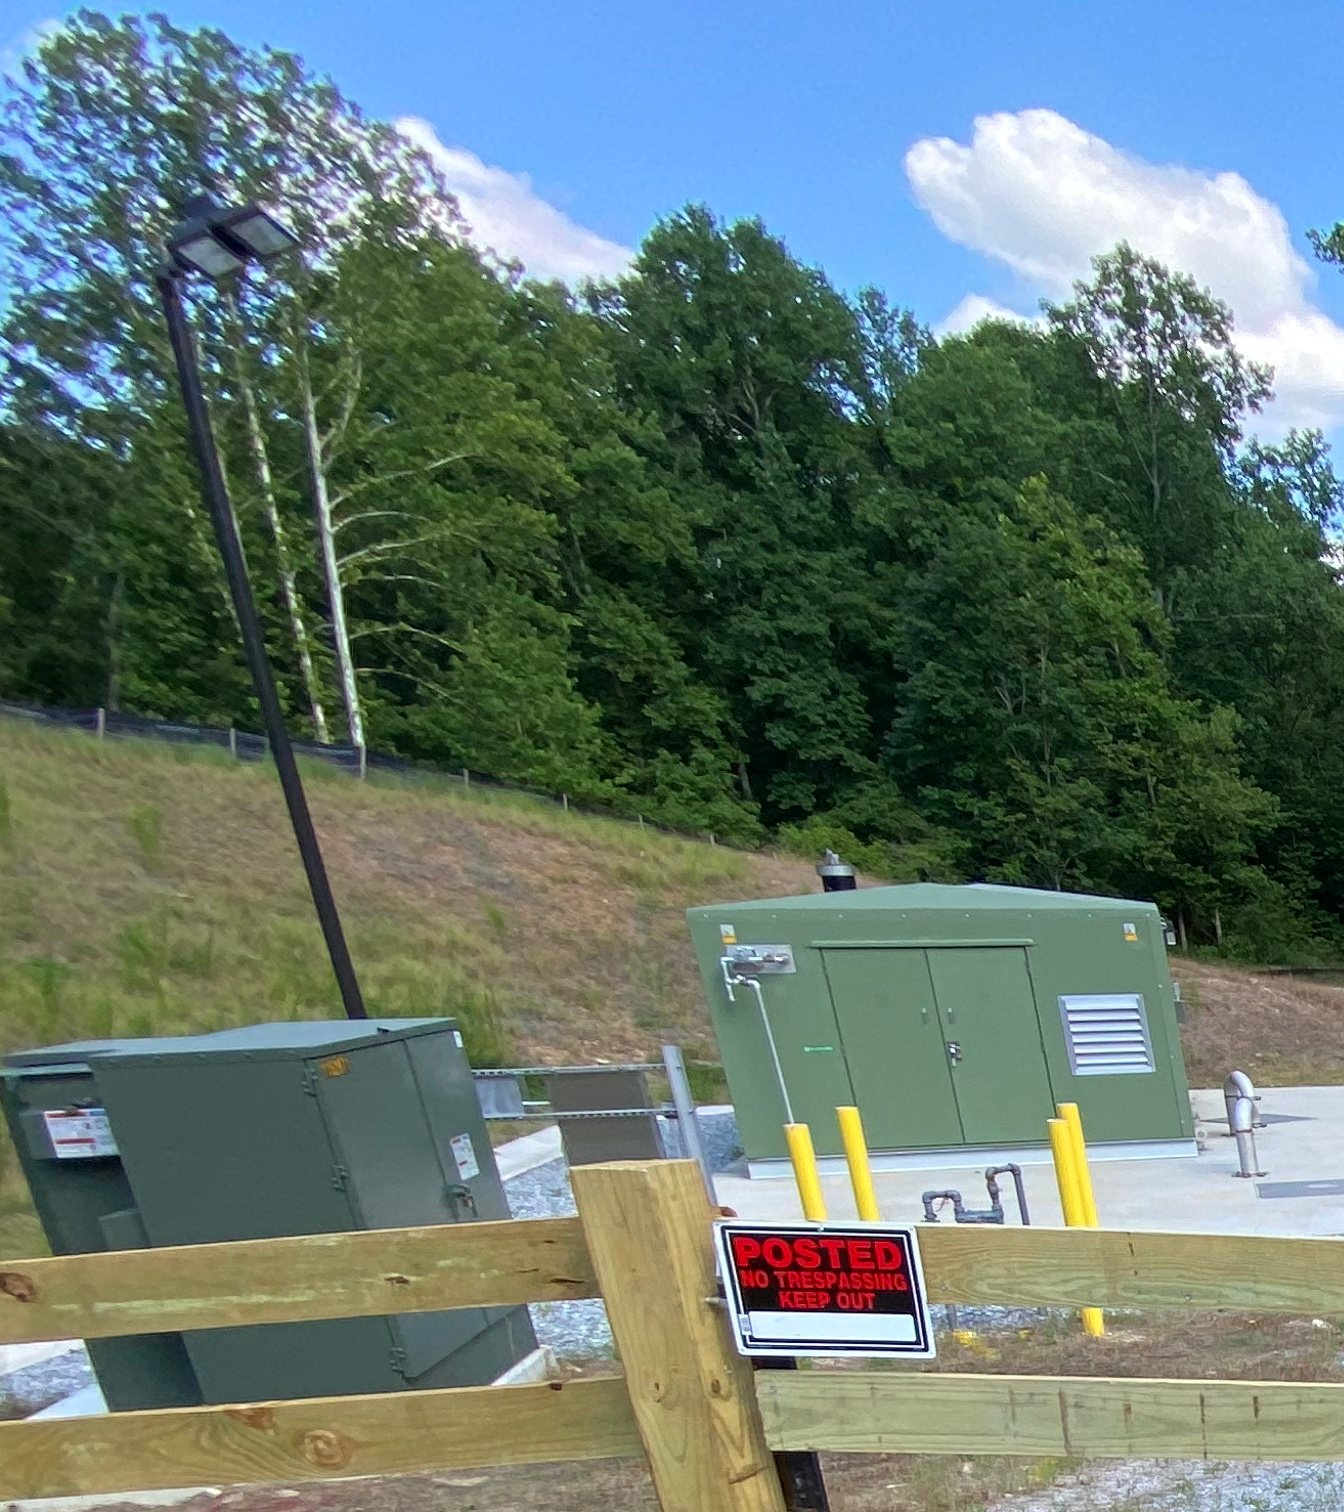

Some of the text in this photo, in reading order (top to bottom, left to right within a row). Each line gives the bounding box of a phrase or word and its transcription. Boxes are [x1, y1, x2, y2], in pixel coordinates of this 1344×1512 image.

[733, 1236, 902, 1270] POSTED
[740, 1270, 908, 1290] NO TRESPASSING
[778, 1291, 875, 1309] KEEP OUT
